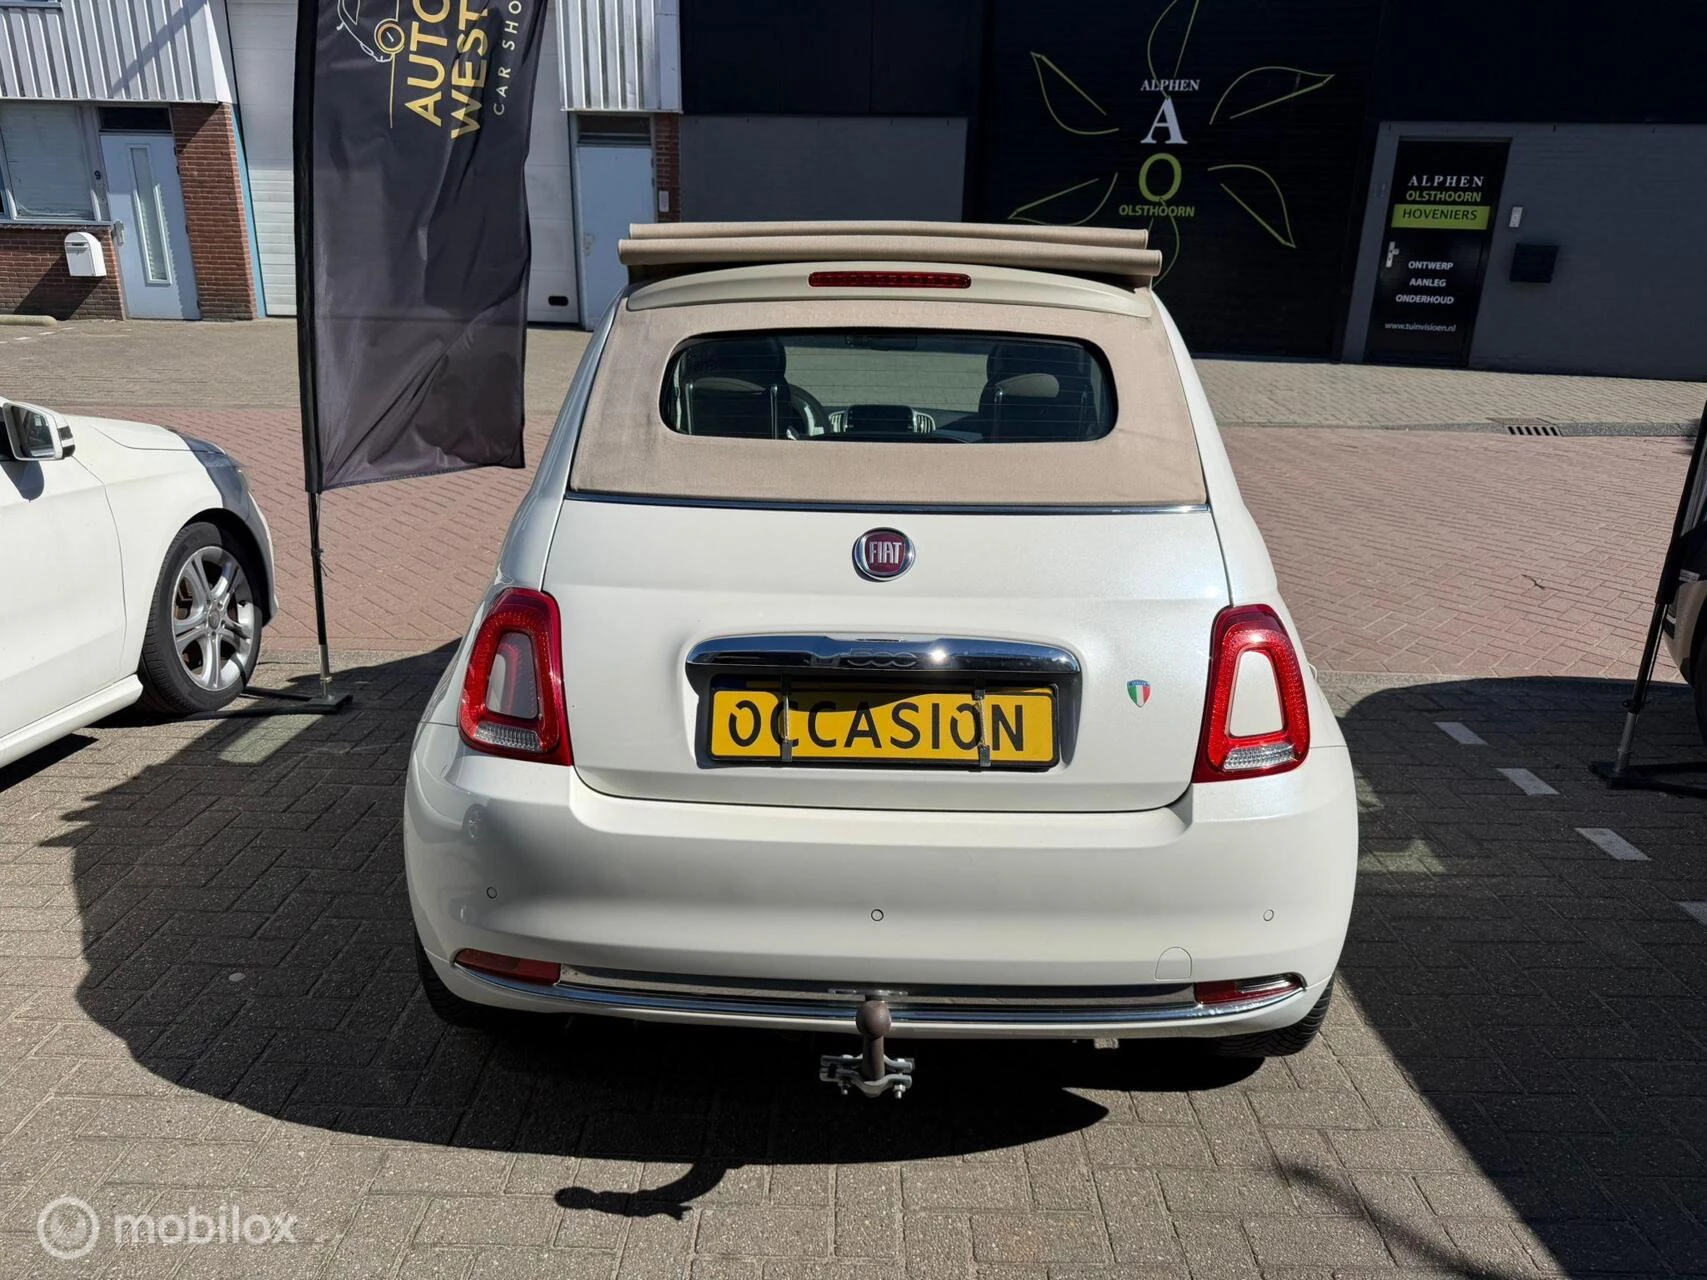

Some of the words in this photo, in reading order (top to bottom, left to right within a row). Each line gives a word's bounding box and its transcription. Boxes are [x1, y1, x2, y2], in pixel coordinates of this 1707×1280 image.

[451, 0, 489, 139] WEST
[493, 67, 512, 116] CAR
[1140, 79, 1201, 92] ALPHEN
[1140, 95, 1189, 145] A
[1138, 153, 1183, 202] O
[1408, 175, 1485, 188] ALPHEN
[1406, 190, 1482, 203] OLSTHOORN
[1118, 204, 1196, 218] OLSTHOORN
[1402, 208, 1478, 221] HOVENIERS
[1408, 260, 1454, 271] ONTWERP
[1409, 278, 1447, 288] AANLEG
[1395, 294, 1455, 305] ONDERHOUD
[869, 541, 903, 564] FIAT
[727, 699, 1025, 752] OCCASION
